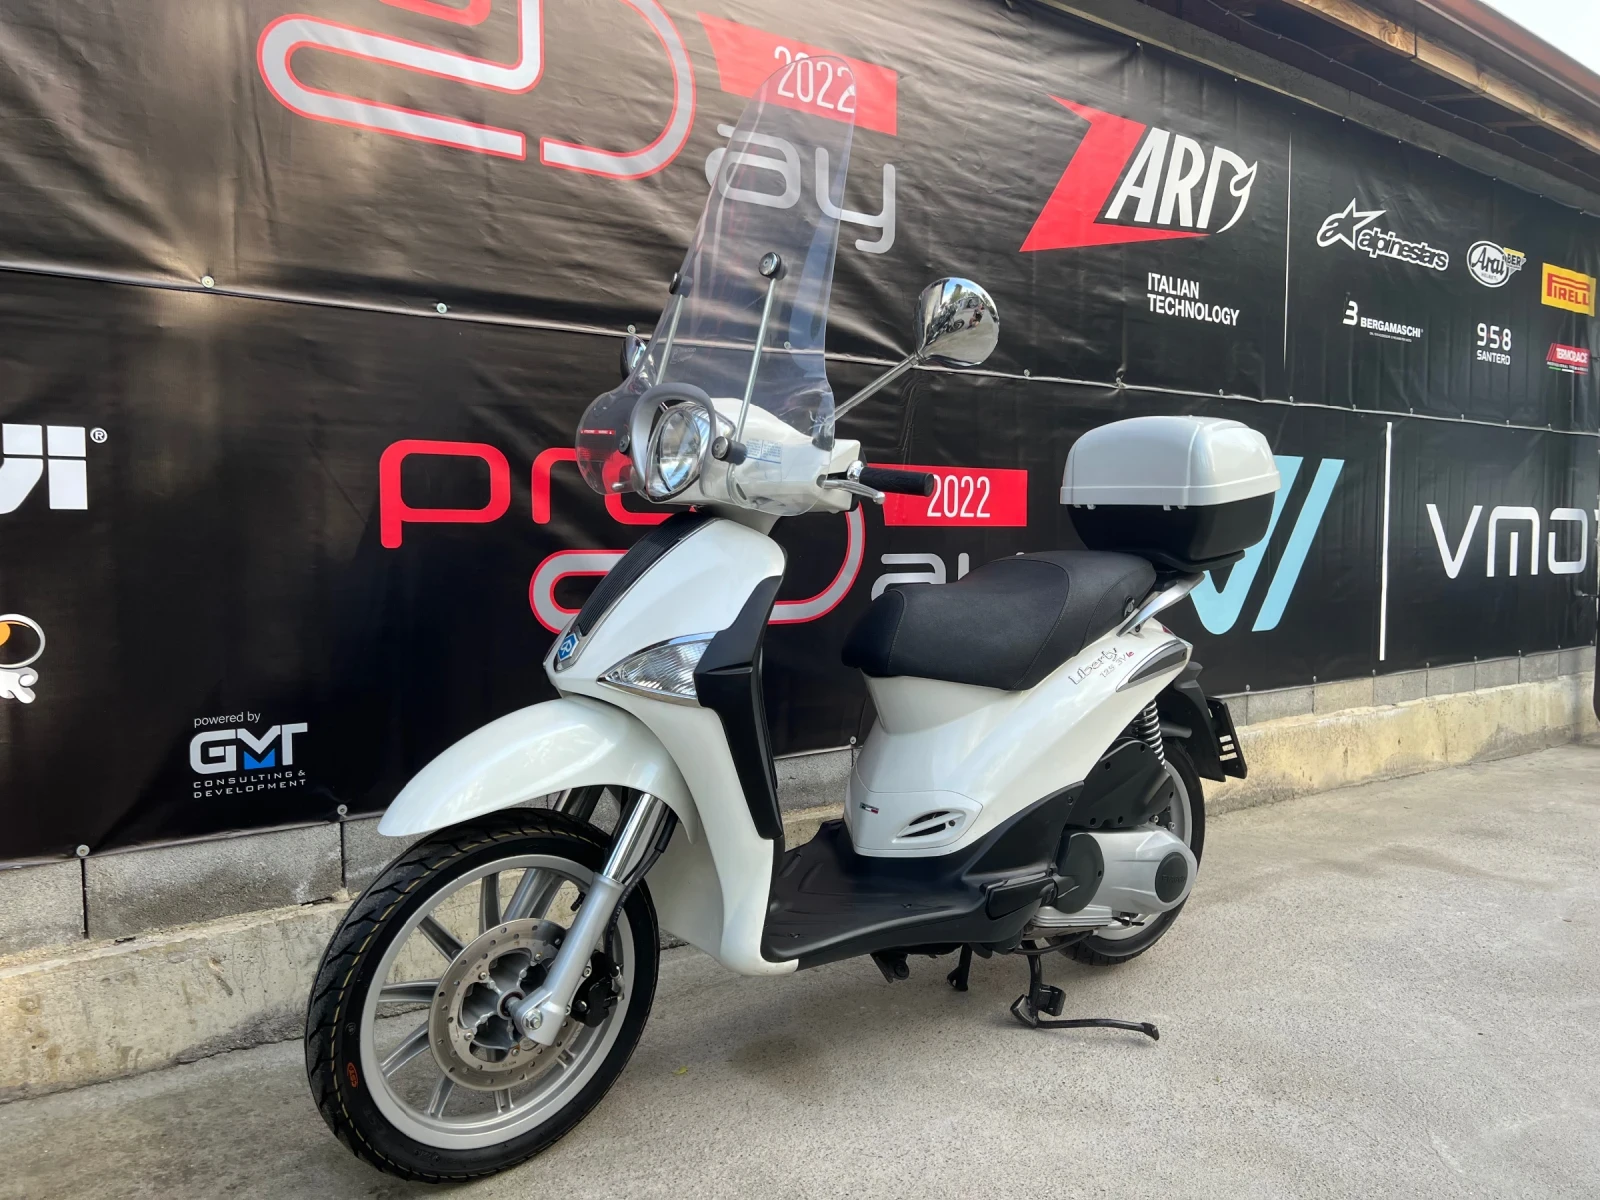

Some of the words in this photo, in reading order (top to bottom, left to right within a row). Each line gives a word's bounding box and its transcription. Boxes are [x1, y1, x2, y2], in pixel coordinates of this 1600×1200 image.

[773, 45, 856, 114] 2022
[1357, 226, 1449, 271] alpinestars
[1470, 246, 1505, 276] Arai
[1147, 272, 1200, 299] ITALIAN
[1147, 293, 1240, 326] TECHNOLOGY
[1476, 349, 1511, 366] SANTERO
[926, 474, 991, 519] 2022
[194, 711, 244, 728] powered
[247, 711, 261, 724] by
[190, 722, 308, 775] GMT
[193, 771, 293, 789] CONSULTING
[297, 769, 306, 777] &
[193, 779, 306, 799] DEVELOPMENT
